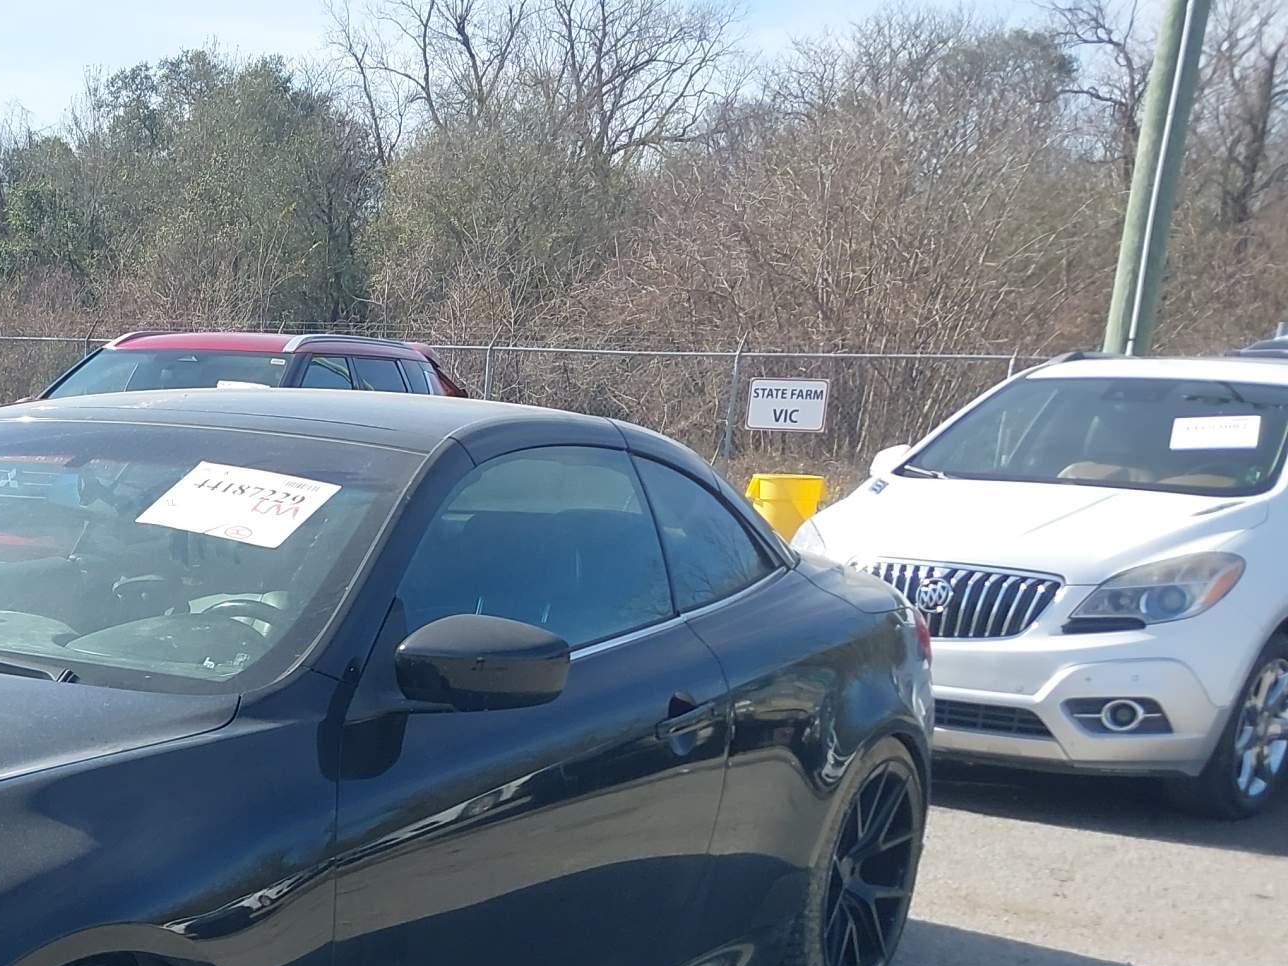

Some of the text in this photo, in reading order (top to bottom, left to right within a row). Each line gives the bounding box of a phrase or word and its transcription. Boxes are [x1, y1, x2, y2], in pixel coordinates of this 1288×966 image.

[753, 388, 824, 400] STATE FARM
[773, 409, 800, 423] VIC
[194, 478, 306, 505] 44187229
